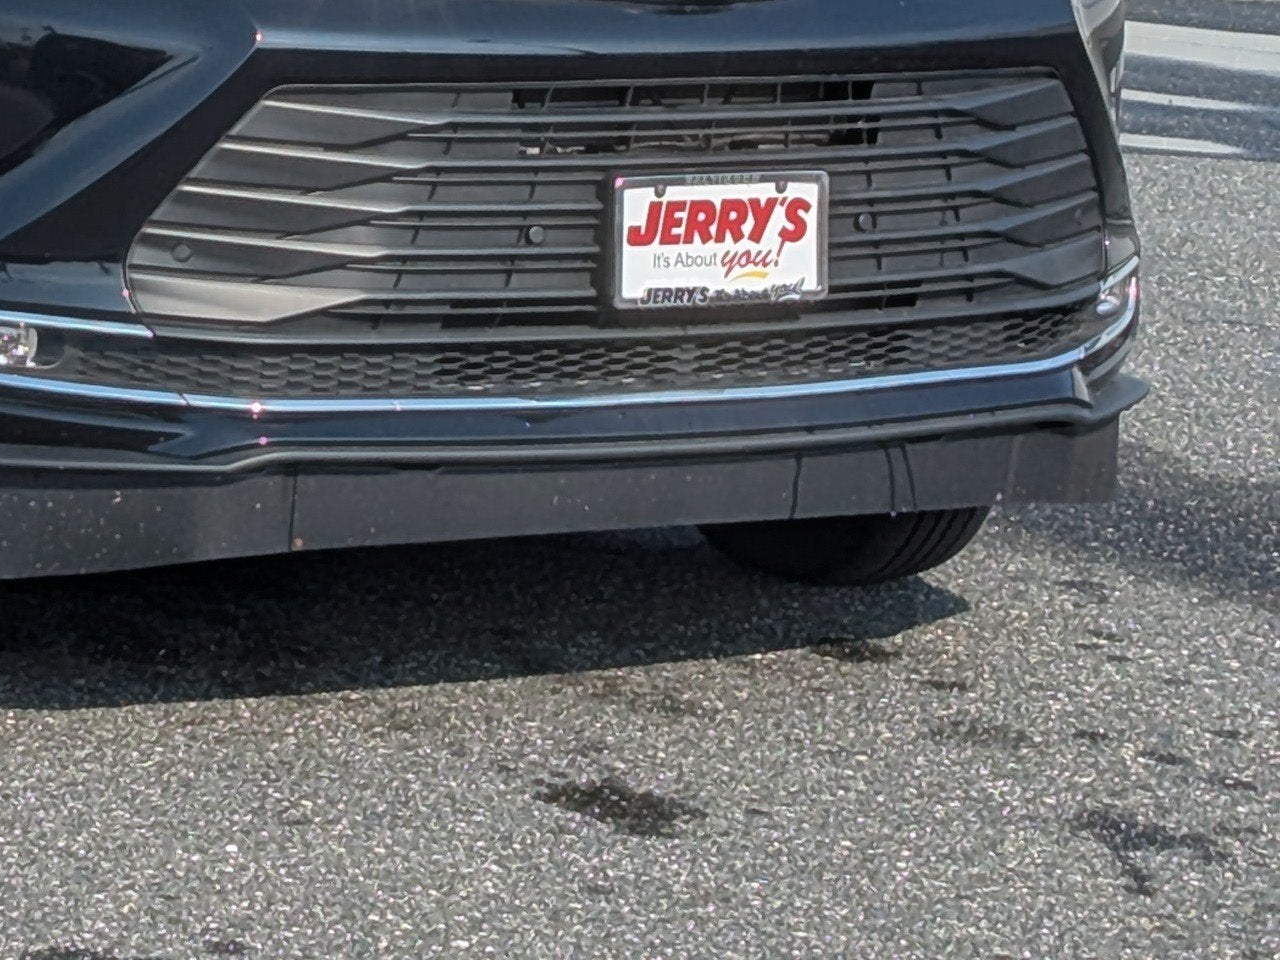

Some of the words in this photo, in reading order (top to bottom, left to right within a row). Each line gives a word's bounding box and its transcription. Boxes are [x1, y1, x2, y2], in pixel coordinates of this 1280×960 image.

[628, 197, 812, 246] JERRY'S
[653, 254, 671, 268] It's
[674, 254, 718, 268] About
[721, 241, 783, 279] you!
[640, 287, 710, 305] JERRY'S
